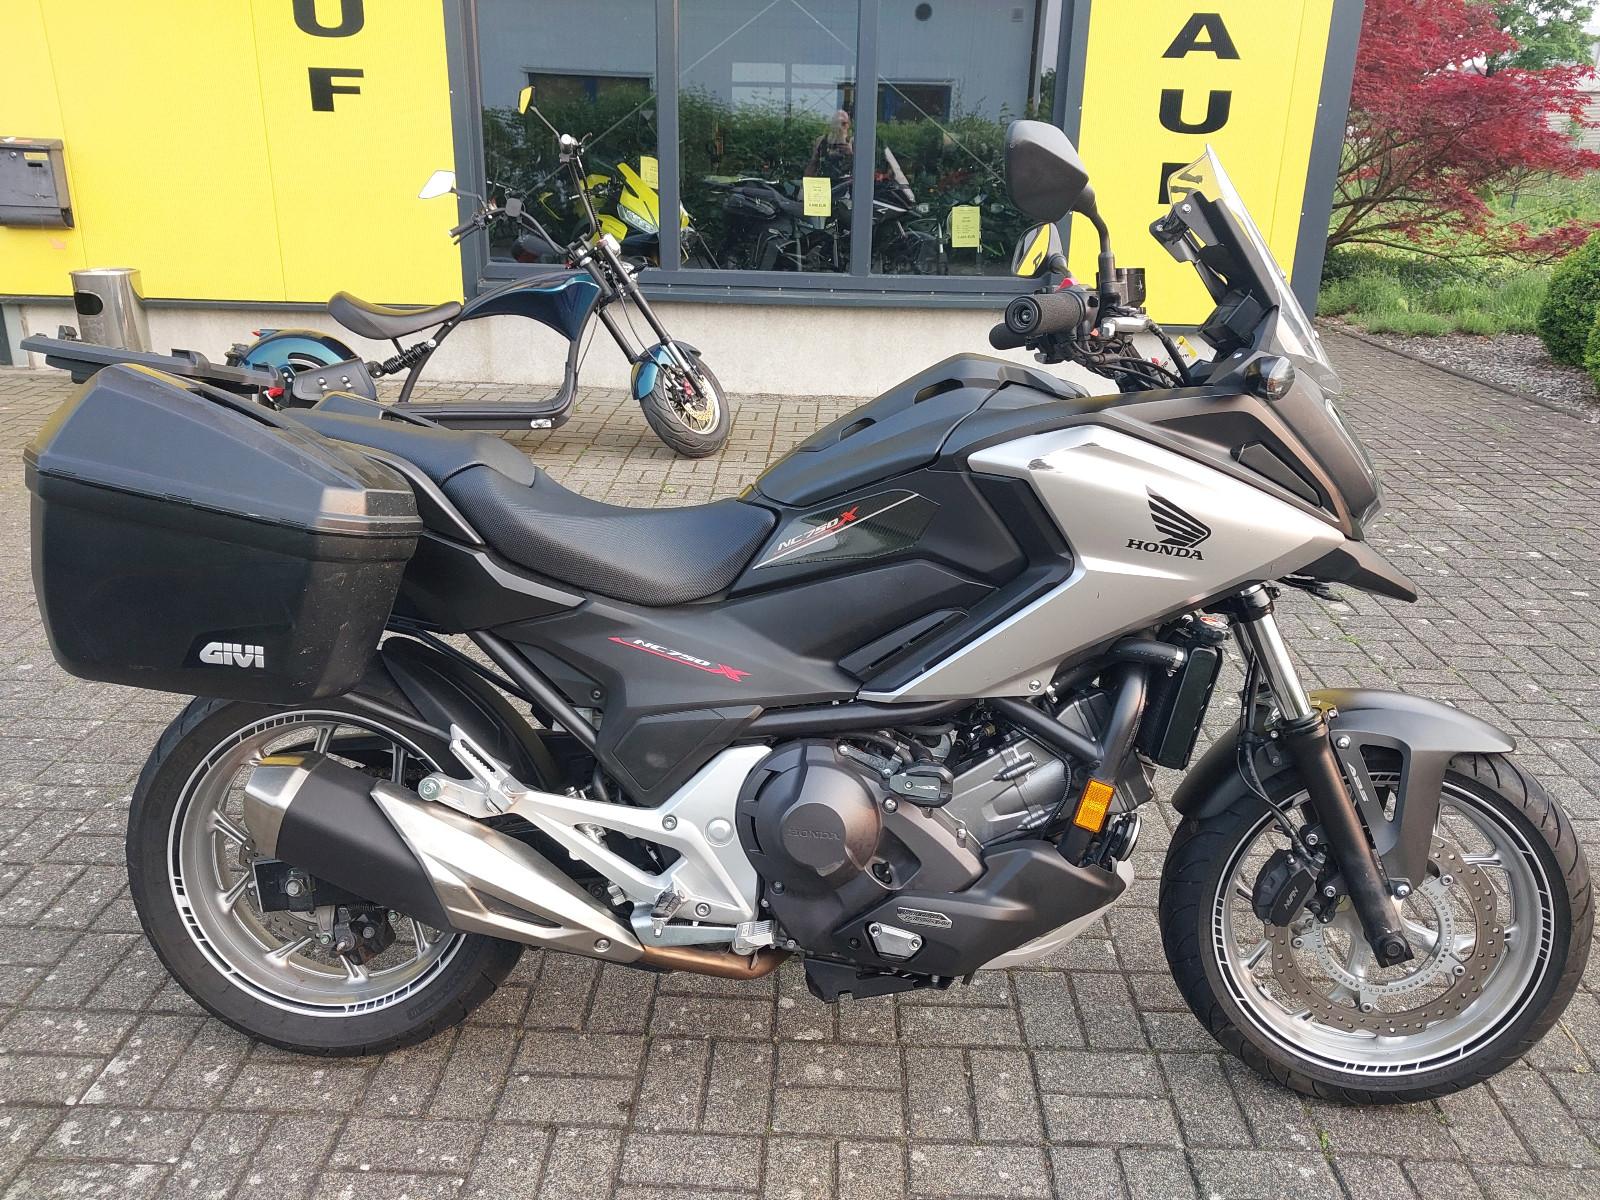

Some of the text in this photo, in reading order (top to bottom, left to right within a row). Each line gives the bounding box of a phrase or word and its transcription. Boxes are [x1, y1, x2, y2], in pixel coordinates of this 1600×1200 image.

[1125, 538, 1205, 561] HONDA
[199, 641, 265, 669] GIVI
[1346, 761, 1369, 802] ABS
